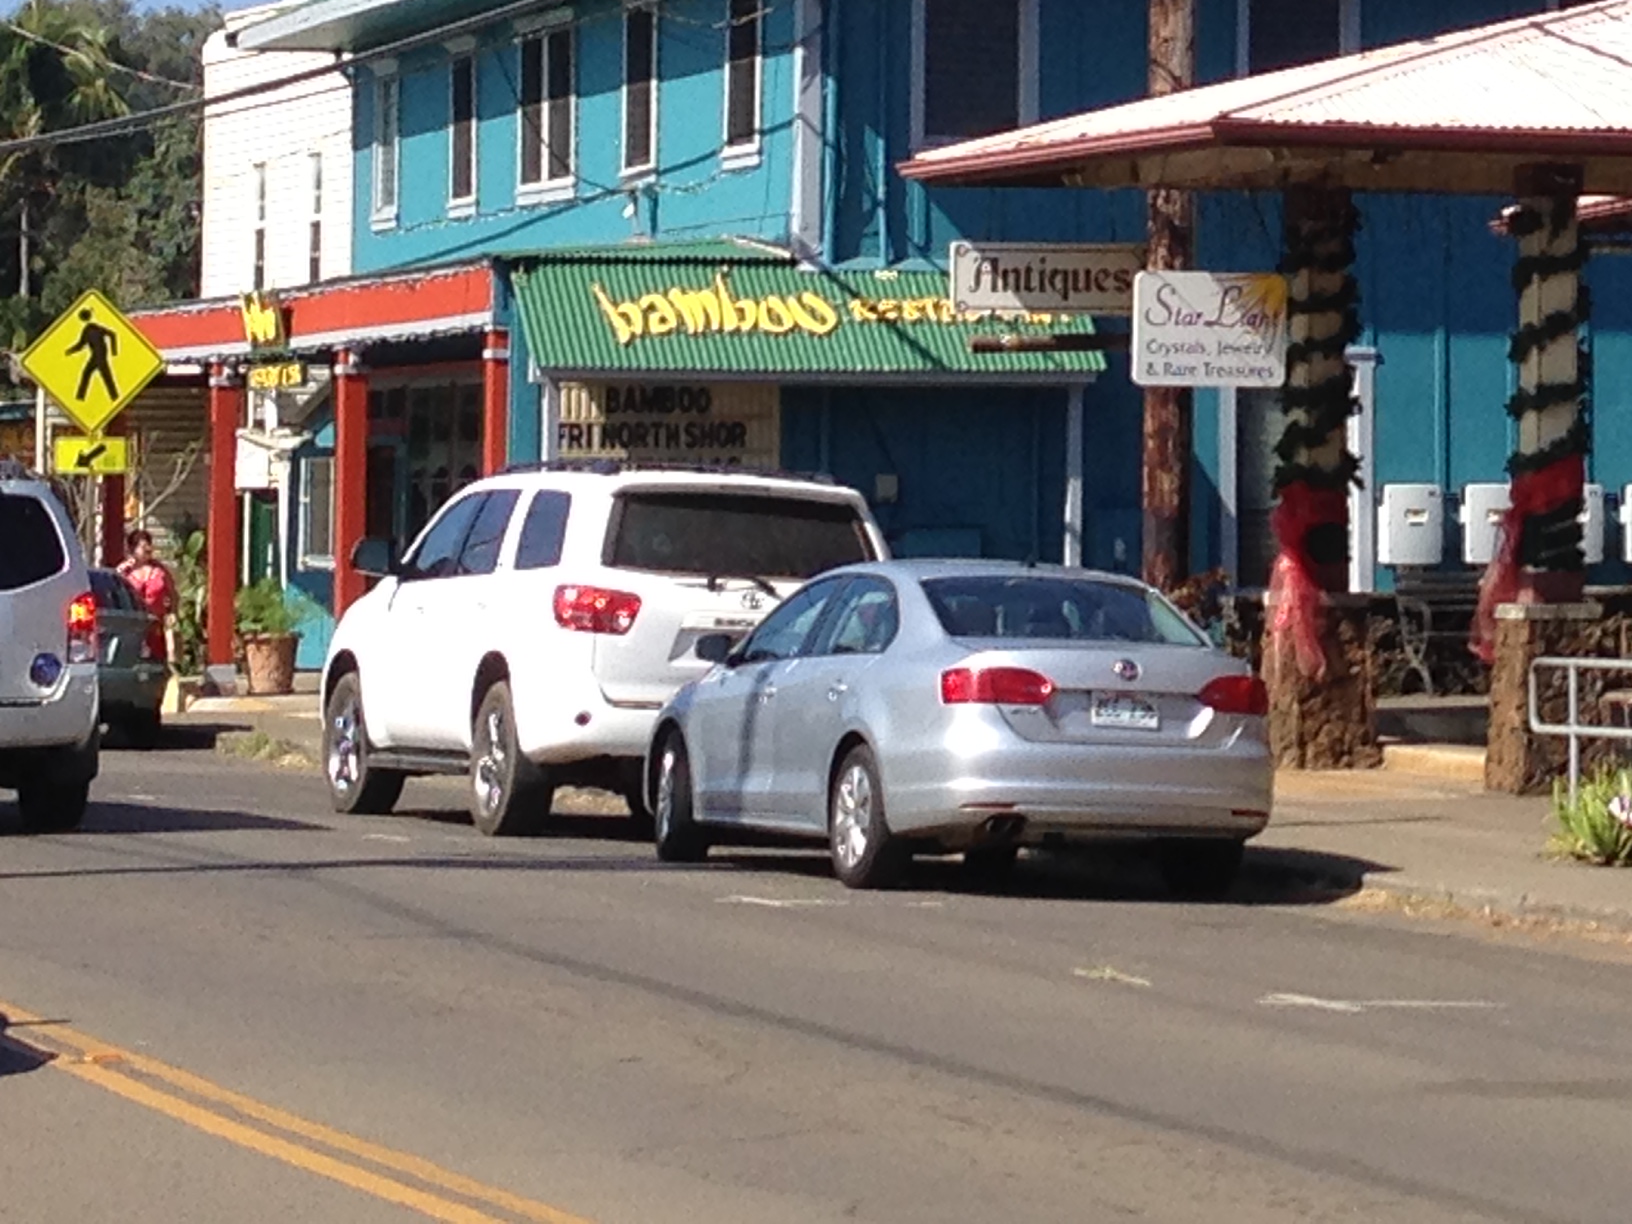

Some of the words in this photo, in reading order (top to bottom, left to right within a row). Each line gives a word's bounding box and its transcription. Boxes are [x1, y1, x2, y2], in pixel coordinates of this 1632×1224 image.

[968, 256, 1132, 301] Antiques
[591, 272, 837, 345] bamboo
[1145, 283, 1204, 327] Star
[1145, 362, 1160, 376] &
[1163, 362, 1198, 377] Rare
[1203, 362, 1274, 378] Treasures
[605, 384, 712, 415] BAMBOO
[558, 422, 592, 450] FRI
[602, 421, 681, 450] NORTH
